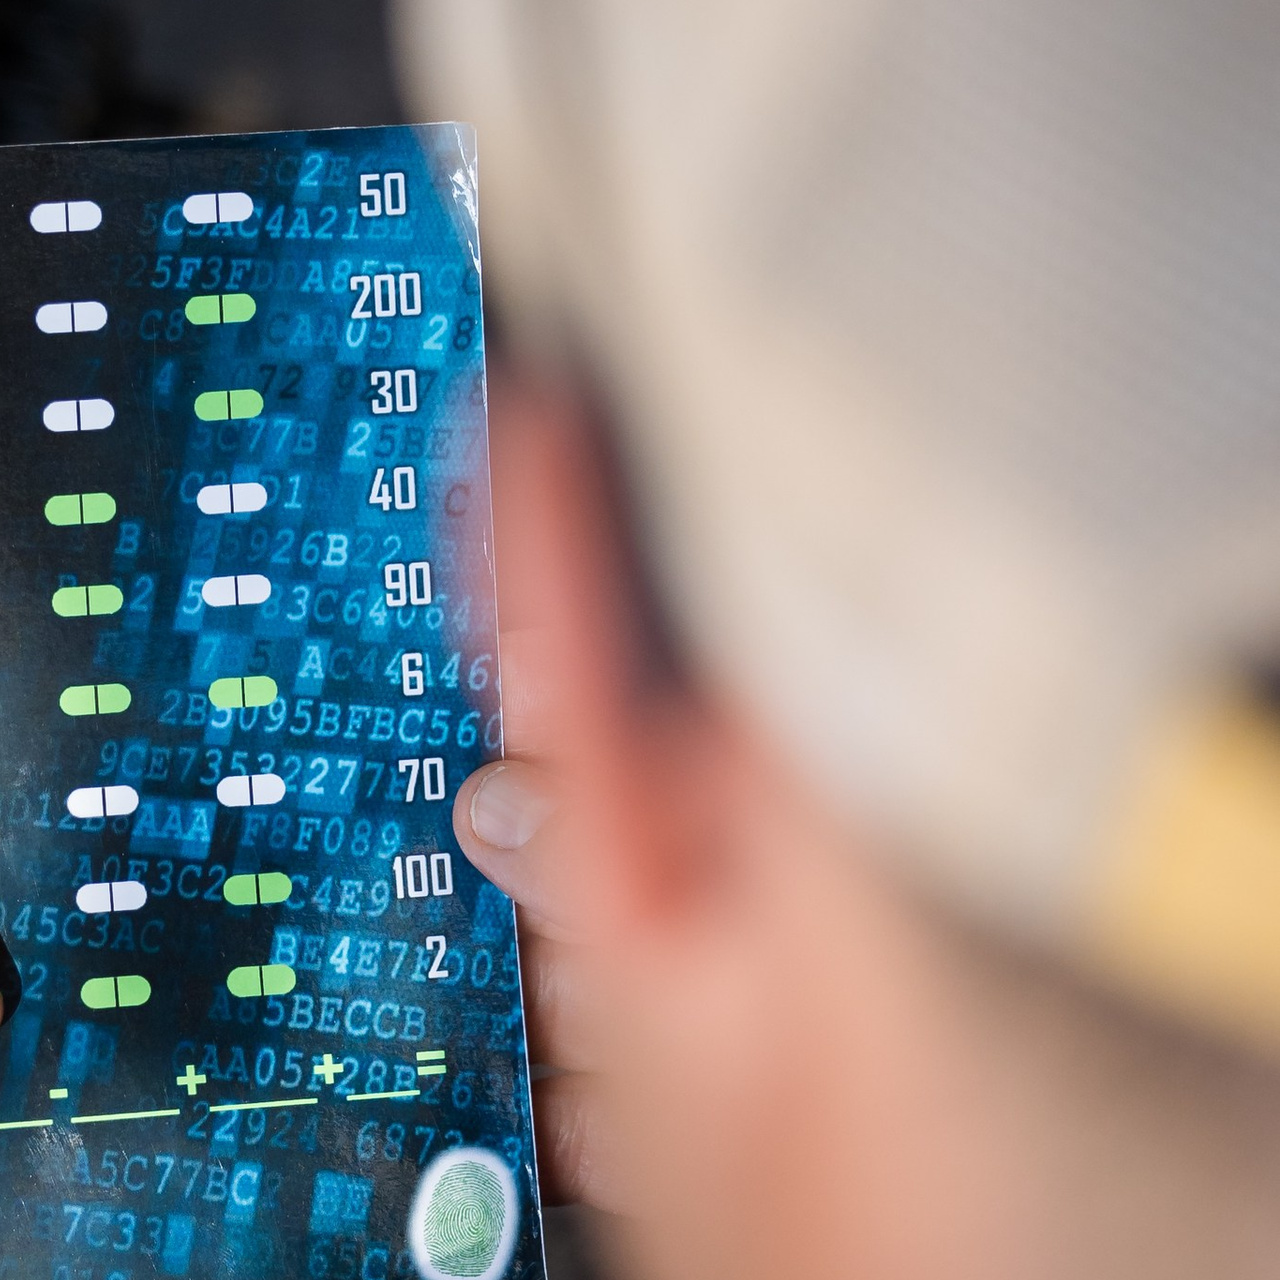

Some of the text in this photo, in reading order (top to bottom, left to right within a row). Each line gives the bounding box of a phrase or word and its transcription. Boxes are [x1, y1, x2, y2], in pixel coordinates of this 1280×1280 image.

[359, 172, 406, 217] 50
[349, 272, 422, 319] 200
[369, 368, 418, 415] 30
[368, 466, 417, 512] 40
[383, 561, 432, 608] 90
[401, 651, 424, 697] 6
[398, 757, 446, 803] 70
[392, 852, 453, 899] 100
[424, 934, 450, 980] 2
